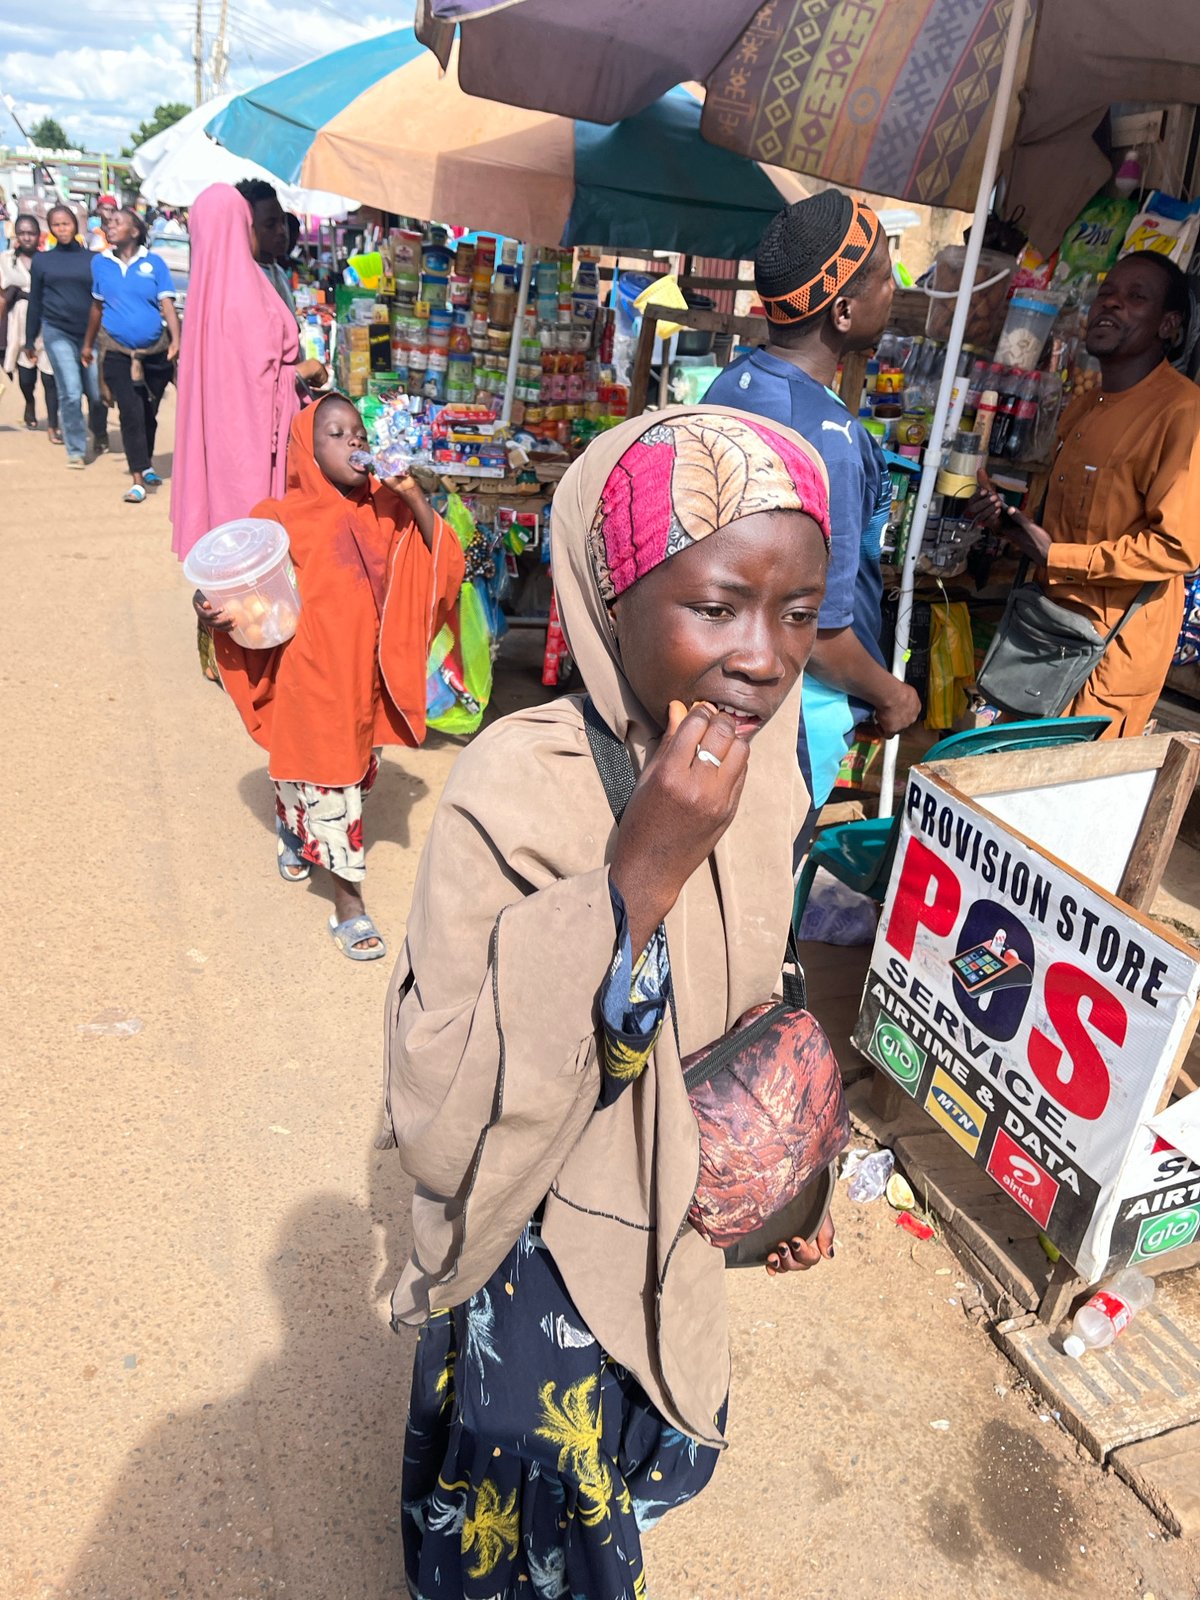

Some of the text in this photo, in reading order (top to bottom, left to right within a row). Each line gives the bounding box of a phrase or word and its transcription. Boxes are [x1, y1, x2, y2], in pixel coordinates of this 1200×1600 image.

[907, 782, 1168, 1008] PROVISION STORE
[886, 835, 1128, 1121] POS
[871, 983, 1081, 1196] AIRTIME & DATA
[882, 1035, 912, 1069] glo
[887, 958, 1077, 1153] SERVICE.
[936, 1092, 975, 1130] MTN
[1002, 1174, 1034, 1210] airtel
[1148, 1221, 1189, 1250] glo
